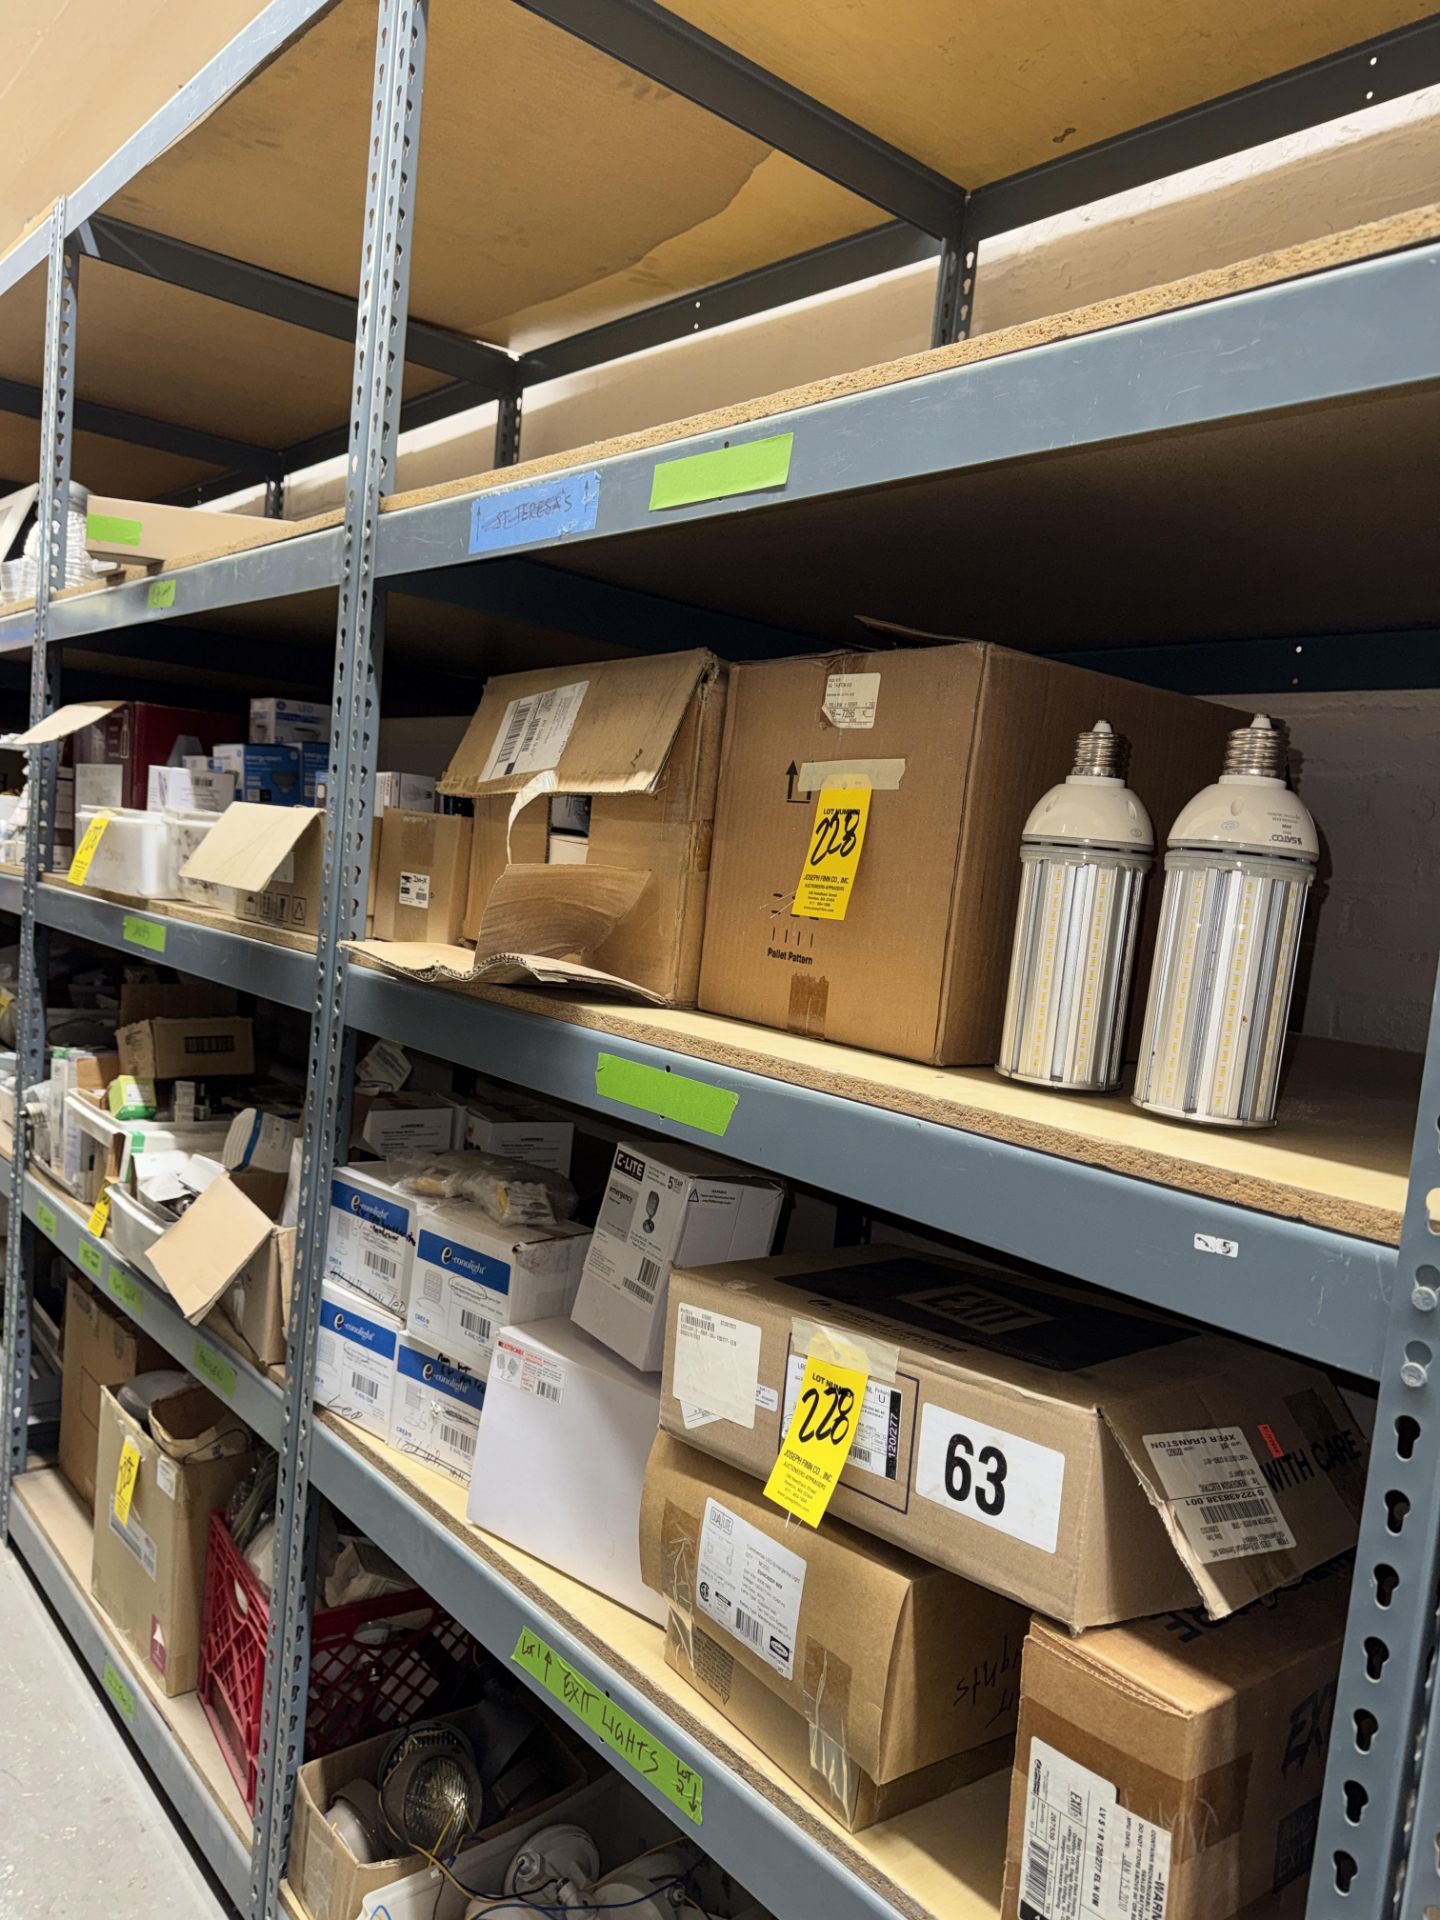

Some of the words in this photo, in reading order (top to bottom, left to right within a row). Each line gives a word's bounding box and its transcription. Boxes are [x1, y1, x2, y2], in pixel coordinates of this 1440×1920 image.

[810, 810, 860, 866] 228
[1271, 834, 1298, 844] SATCO
[767, 946, 787, 961] Pallet
[787, 951, 813, 966] Pattern
[616, 1152, 645, 1178] C-LITE
[667, 1175, 675, 1190] 5
[1222, 1241, 1231, 1254] 5
[812, 1371, 826, 1385] LOT
[799, 1386, 855, 1445] 228
[887, 1411, 900, 1460] 120/277
[1150, 1435, 1207, 1450] CRANSTON
[1209, 1434, 1235, 1444] XFER
[784, 1449, 802, 1465] JOSEPH
[801, 1458, 813, 1471] FINN
[1259, 1449, 1315, 1493] WITH
[1312, 1429, 1362, 1473] CARE
[944, 1432, 1008, 1517] 63
[562, 1671, 600, 1713] EXIT
[600, 1704, 660, 1774] LIGHTS
[1069, 1791, 1083, 1817] EXIT
[1096, 1833, 1105, 1841] R
[1138, 1822, 1144, 1832] DO
[1094, 1842, 1105, 1873] 120/277
[1149, 1829, 1157, 1862] CONTAINS
[1093, 1873, 1101, 1885] EL
[1133, 1870, 1141, 1891] ABOVE
[1144, 1863, 1154, 1912] RECHARGEABLE
